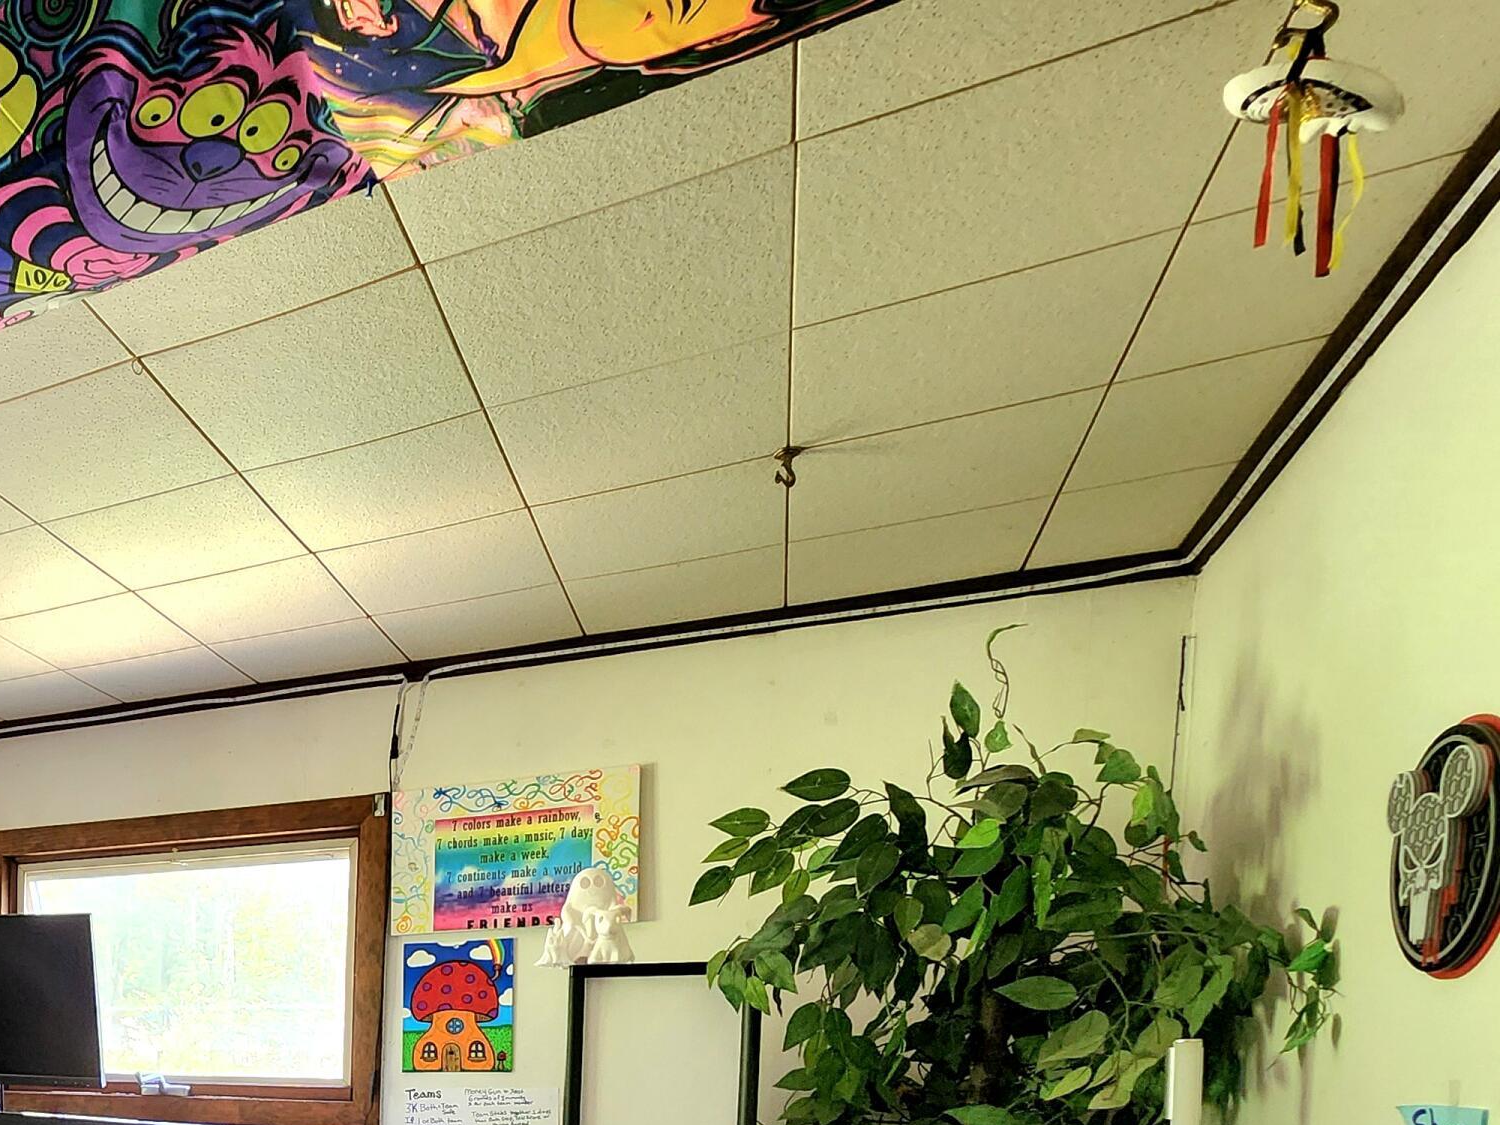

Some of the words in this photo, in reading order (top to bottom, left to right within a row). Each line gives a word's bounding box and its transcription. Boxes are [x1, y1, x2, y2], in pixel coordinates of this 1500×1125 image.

[25, 269, 67, 290] 10/6
[452, 820, 458, 831] 7
[462, 817, 491, 831] colors
[496, 814, 521, 828] make
[526, 815, 532, 825] a
[537, 810, 581, 824] rainbow,
[437, 838, 442, 850] 7
[447, 836, 478, 850] chords
[483, 834, 509, 847] make
[514, 834, 520, 844] a
[525, 829, 556, 843] music,
[559, 827, 565, 840] 7
[480, 850, 505, 864] make
[511, 852, 516, 861] a
[457, 869, 506, 882] continents
[511, 865, 537, 879] make
[543, 867, 548, 876] a
[457, 887, 474, 900] and
[490, 883, 533, 898] beautiful
[538, 882, 570, 895] letters
[491, 902, 517, 914] make
[522, 902, 533, 913] us
[467, 915, 554, 930] FRIENDS
[405, 1089, 442, 1100] Teams
